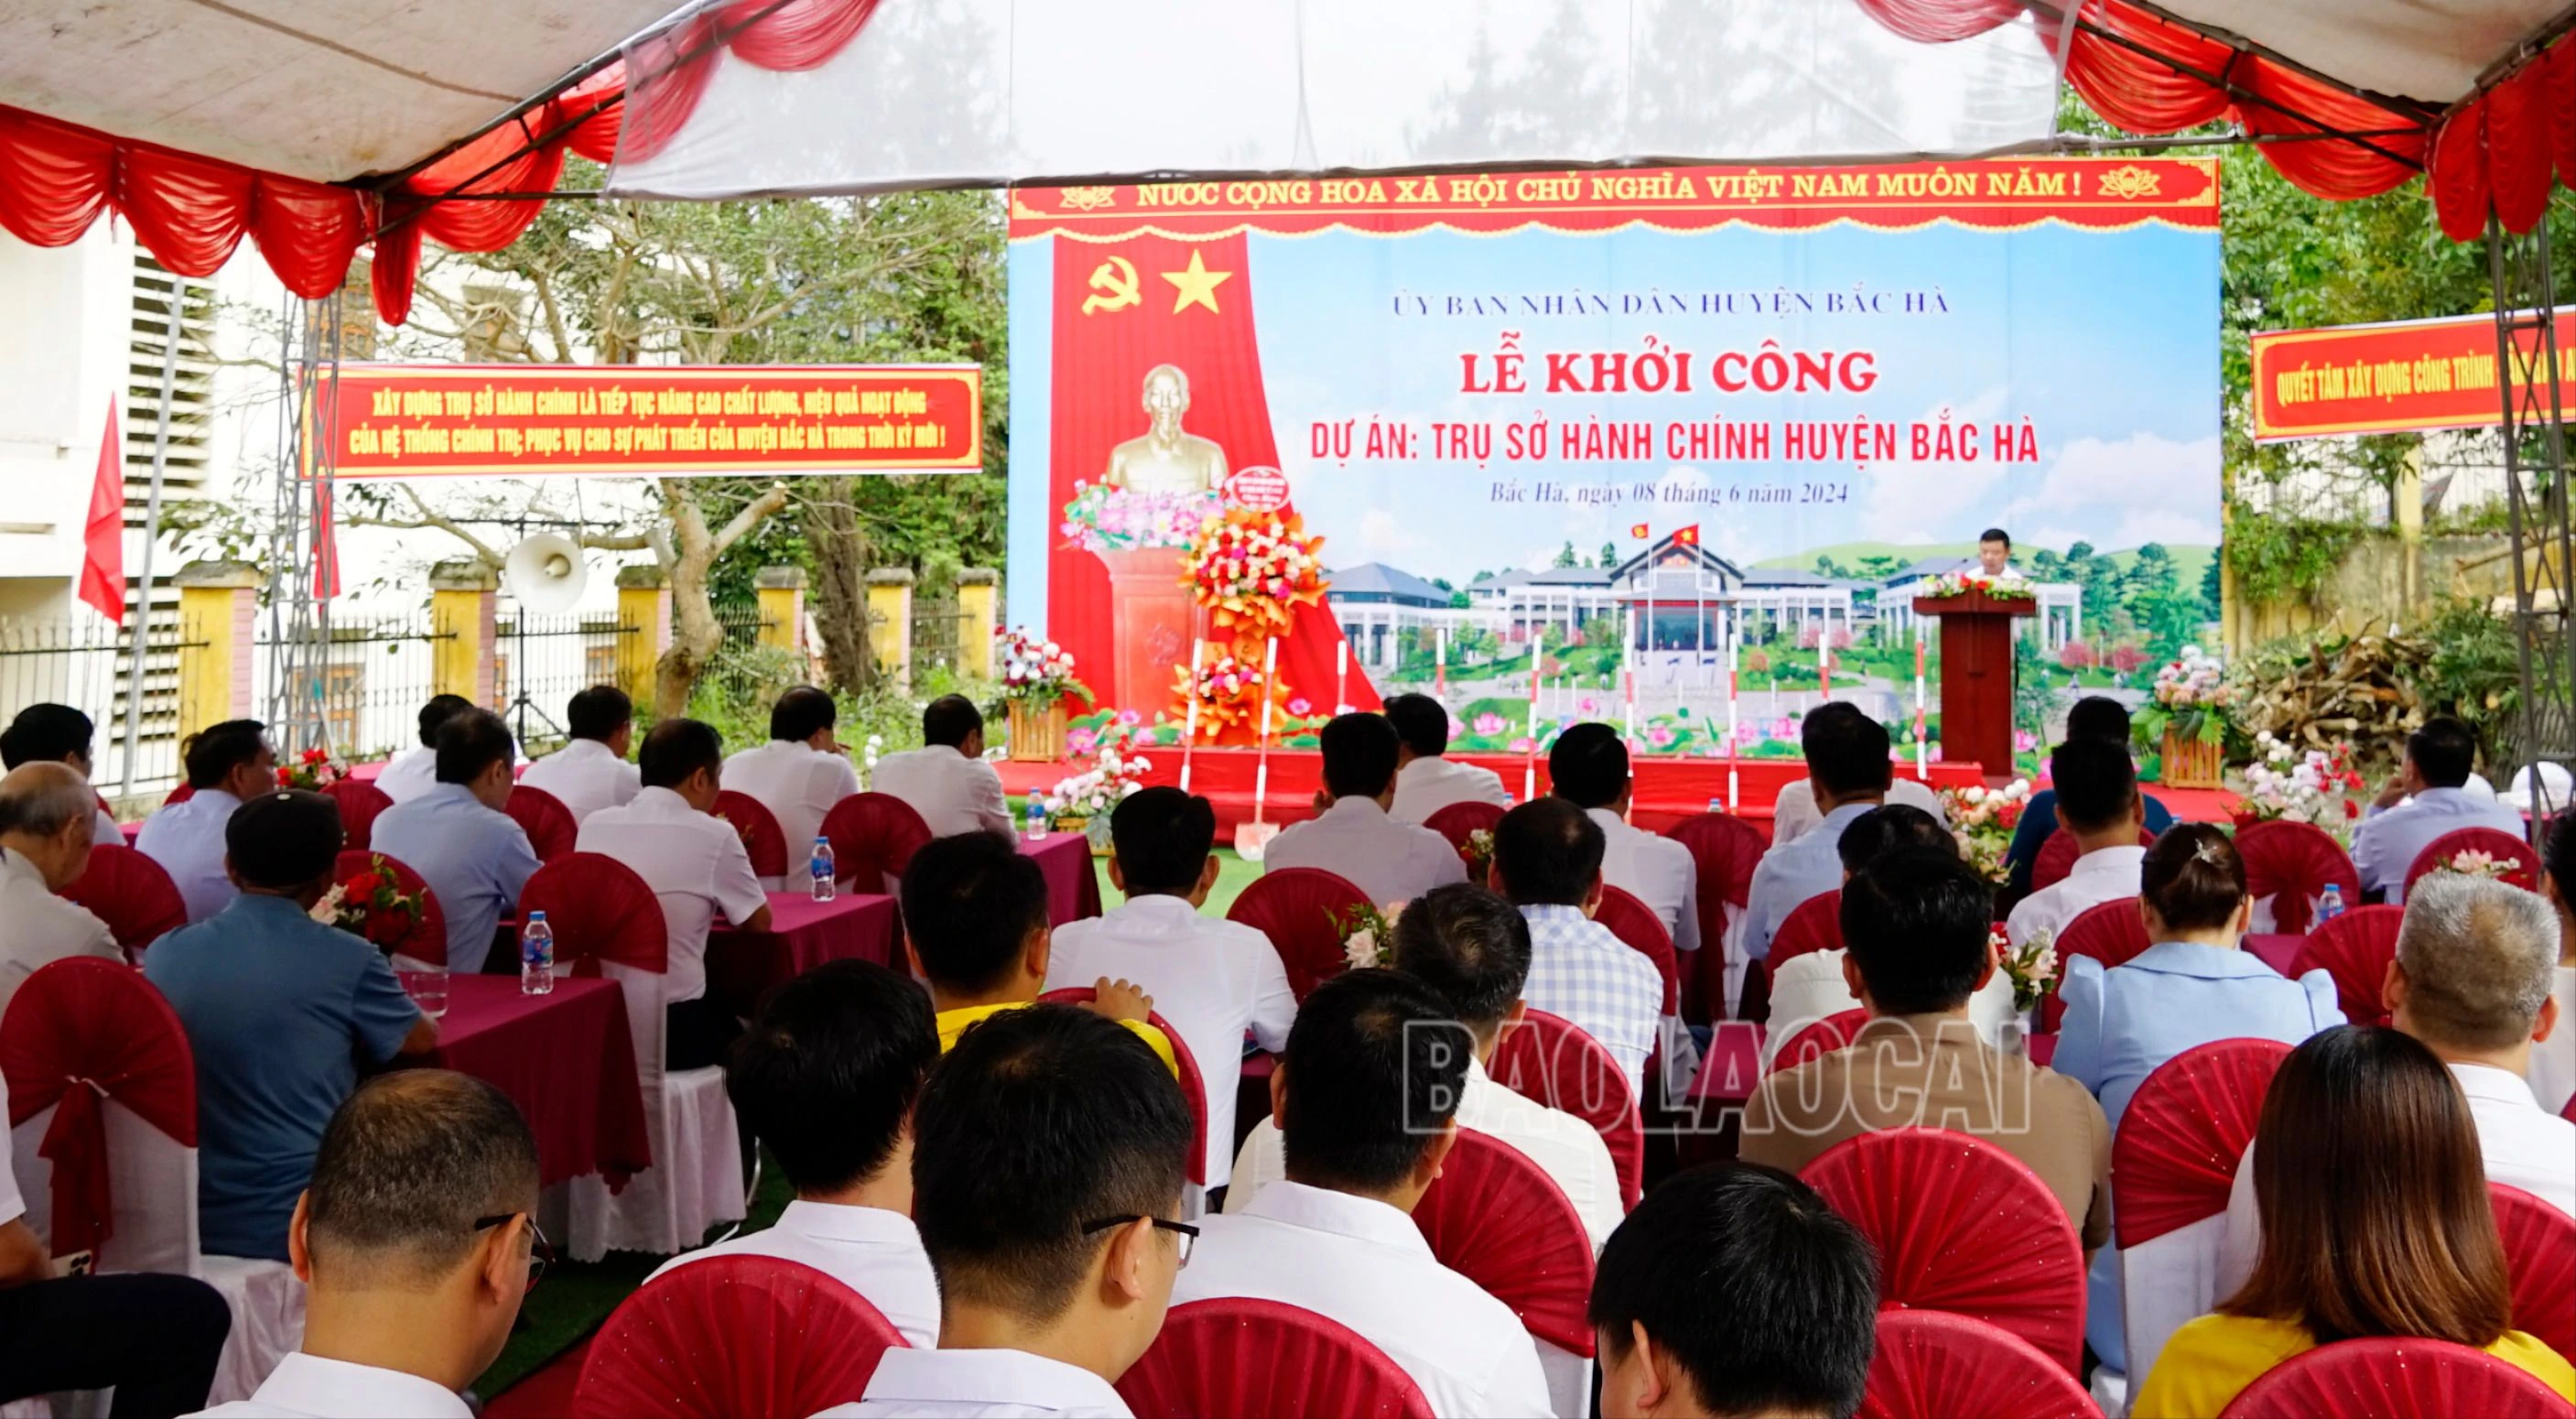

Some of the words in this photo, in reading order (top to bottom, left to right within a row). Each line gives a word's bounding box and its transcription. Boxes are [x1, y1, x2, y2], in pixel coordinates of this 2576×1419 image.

[1394, 175, 1442, 202] XÃ
[1449, 174, 1508, 208] HỘI
[1517, 169, 1580, 202] CHỦ
[1591, 172, 1697, 201] NGHĨA
[1706, 168, 1783, 203] VIỆT
[1792, 173, 1868, 198] NAM
[1878, 166, 1977, 197] MUÔN
[1987, 168, 2067, 197] NĂM
[1393, 288, 1434, 316] ỦY
[1446, 296, 1509, 316] BAN
[1521, 288, 1610, 315] NHÂN
[1623, 287, 1688, 314] DÂN
[1702, 286, 1813, 320] HUYỆN
[1827, 281, 1891, 313] BẮC
[1905, 286, 1948, 312] HÀ
[1460, 330, 1526, 392] LỄ
[1545, 335, 1693, 393] KHỞI
[1713, 339, 1878, 393] CÔNG
[2277, 360, 2315, 407] QUYẾT
[2317, 362, 2345, 401] TÂM
[2346, 359, 2373, 398] XÂY
[2375, 360, 2411, 403] DỰNG
[2413, 353, 2451, 394] CÔNG
[2452, 349, 2494, 391] TRÌNH
[373, 386, 401, 417] XÂY
[404, 389, 443, 421] DỰNG
[444, 391, 472, 420] TRỤ
[474, 384, 496, 416] SỞ
[496, 386, 534, 416] HÀNH
[536, 386, 578, 416] CHÍNH
[579, 386, 598, 416] LÀ
[599, 384, 628, 416] TIẾP
[630, 391, 655, 420] TỤC
[657, 386, 694, 415] NÂNG
[696, 391, 721, 415] CAO
[723, 384, 756, 415] CHẤT
[804, 386, 833, 419] HIỆU
[834, 385, 860, 417] QUẢ
[860, 391, 893, 419] HOẠT
[893, 386, 926, 419] ĐỘNG
[350, 422, 379, 454] CỦA
[382, 424, 401, 459] HỆ
[403, 421, 449, 453] THỐNG
[451, 424, 495, 453] CHÍNH
[525, 428, 562, 457] PHỤC
[564, 428, 582, 457] VỤ
[584, 428, 612, 451] CHO
[613, 425, 634, 457] SỰ
[634, 422, 668, 451] PHÁT
[669, 418, 707, 450] TRIỂN
[709, 419, 735, 450] CỦA
[737, 422, 778, 455] HUYỆN
[780, 418, 806, 450] BẮC
[806, 421, 825, 450] HÀ
[826, 426, 866, 450] TRONG
[867, 420, 894, 449] THỜI
[896, 421, 913, 449] KỲ
[915, 420, 938, 449] MỚI
[1311, 418, 1355, 467] DỰ
[1366, 415, 1418, 460] ÁN:
[1432, 422, 1491, 469] TRỤ
[1506, 410, 1548, 460] SỞ
[1562, 415, 1651, 460] HÀNH
[1667, 415, 1770, 460] CHÍNH
[1785, 415, 1896, 470] HUYỆN
[1910, 408, 1978, 462] BẮC
[1994, 415, 2039, 462] HÀ
[1490, 478, 1527, 503] Bắc
[1577, 482, 1625, 508] ngày
[1633, 482, 1656, 503] 08
[1663, 482, 1722, 508] tháng
[1729, 482, 1740, 504] 6
[1748, 482, 1792, 504] năm
[1800, 482, 1848, 504] 2024
